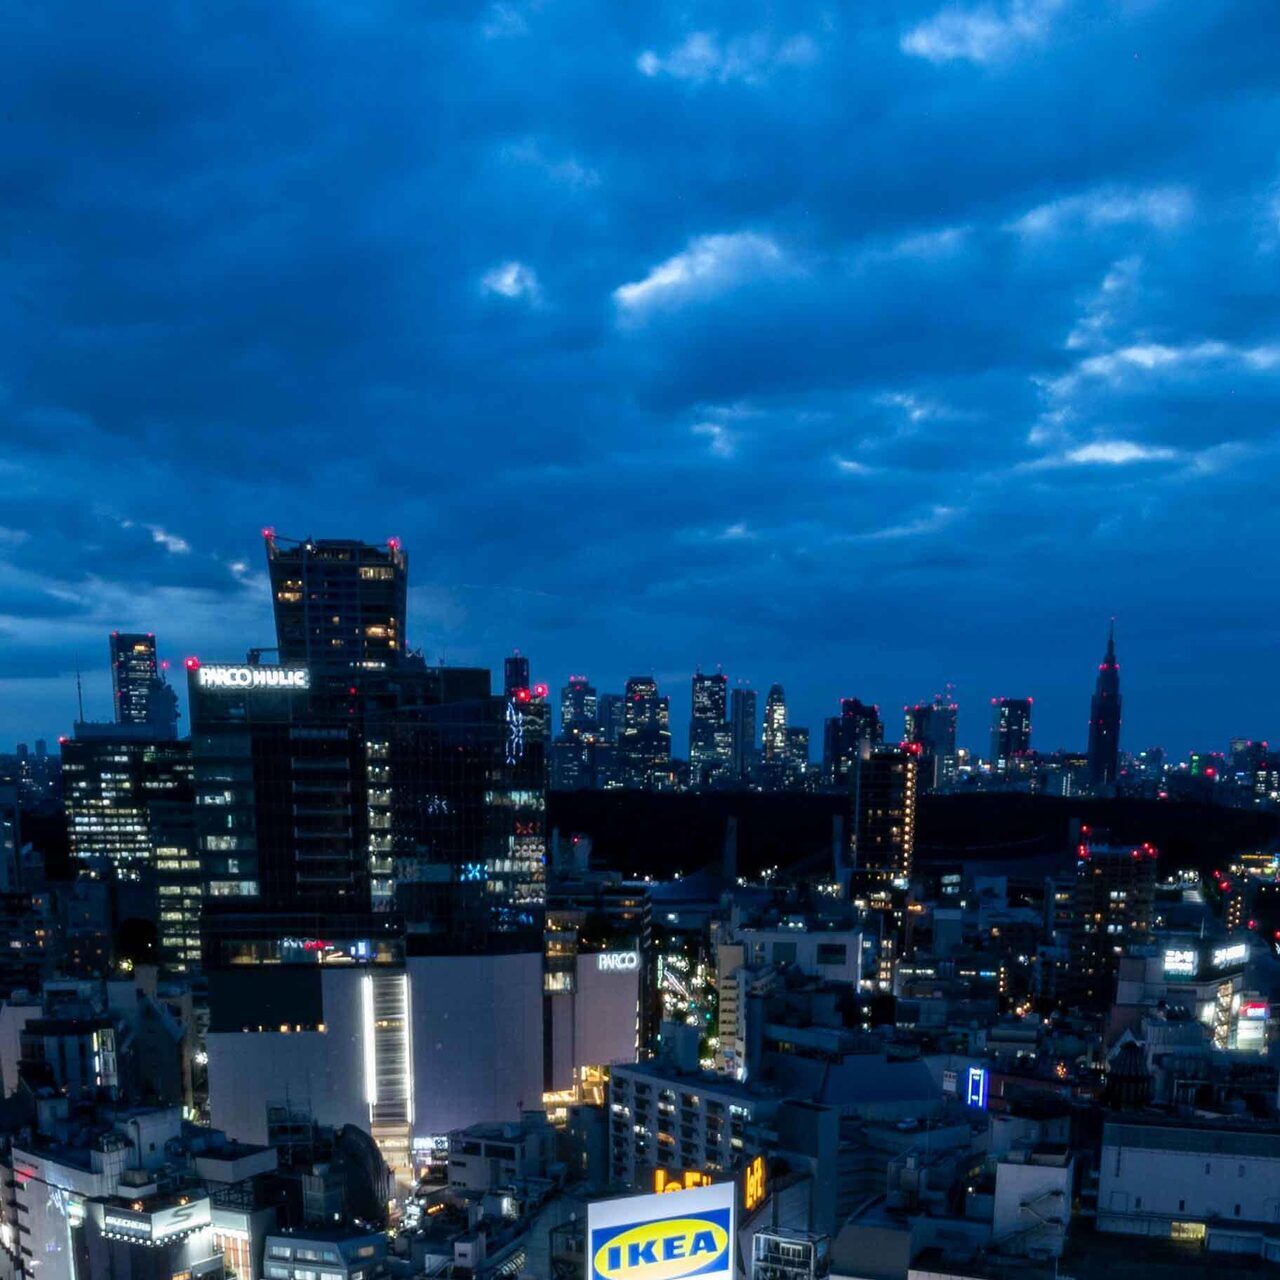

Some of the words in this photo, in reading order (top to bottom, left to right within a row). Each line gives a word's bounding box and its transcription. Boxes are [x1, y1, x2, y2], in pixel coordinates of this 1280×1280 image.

[200, 667, 252, 687] PARCO
[253, 669, 306, 686] HULIC
[598, 952, 637, 970] PARCO
[608, 1230, 718, 1271] IKEA
